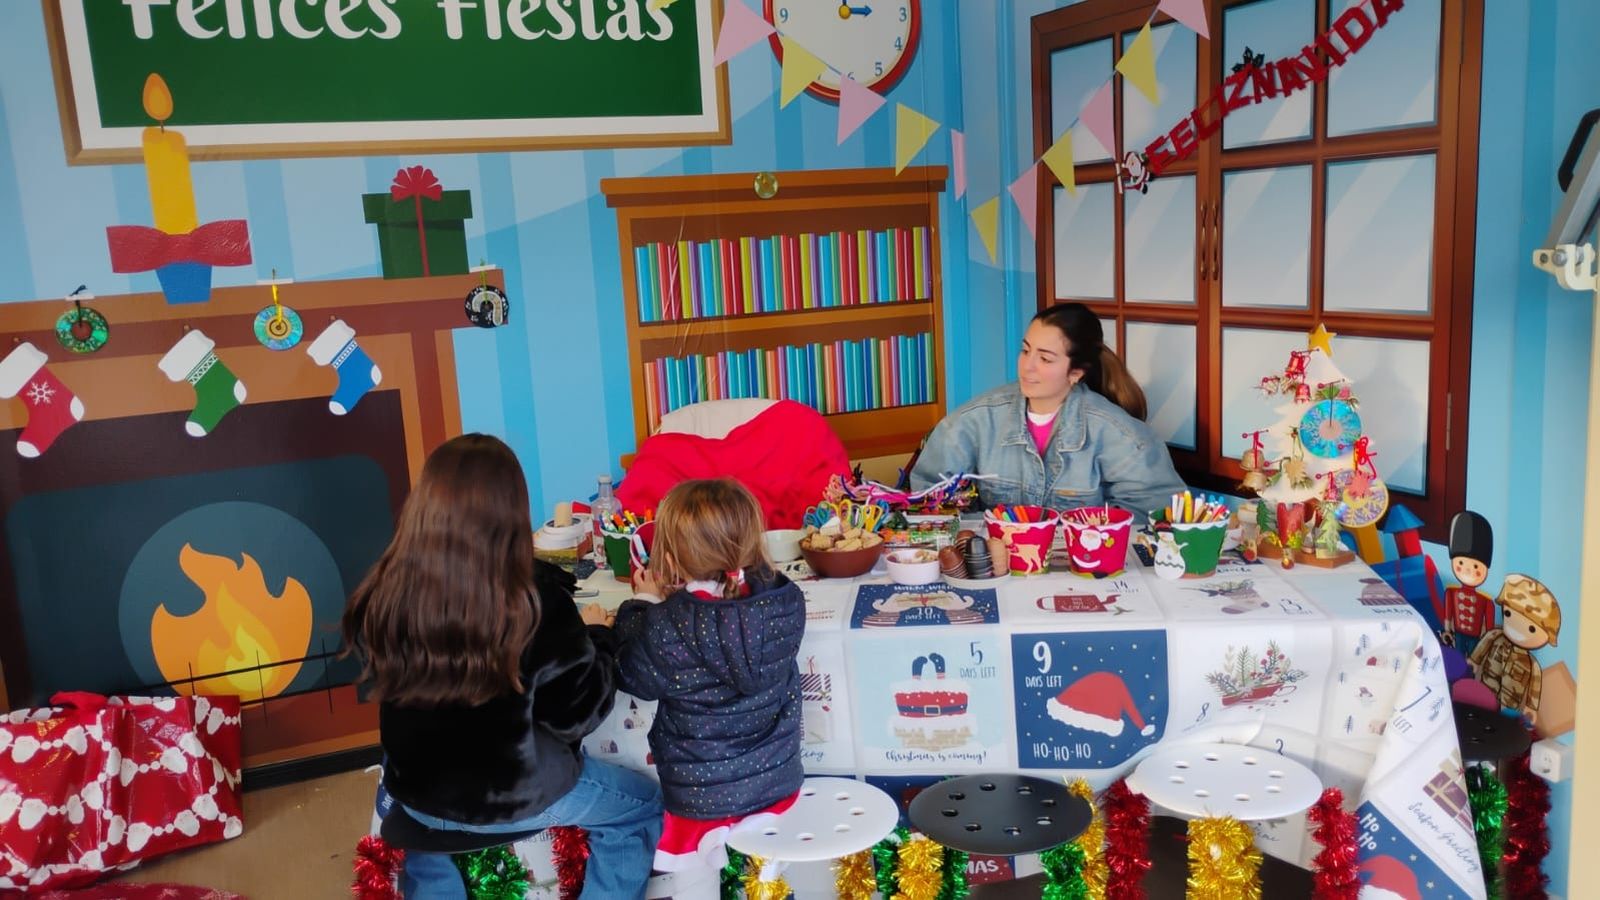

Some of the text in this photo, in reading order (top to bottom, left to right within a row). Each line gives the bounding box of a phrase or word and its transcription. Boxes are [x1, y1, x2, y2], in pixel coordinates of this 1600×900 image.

[437, 0, 673, 41] Fiestas
[779, 8, 788, 23] 9
[898, 7, 907, 22] 3
[894, 36, 903, 51] 4
[874, 61, 883, 77] 5
[969, 641, 983, 665] 5
[1032, 640, 1052, 674] 9
[960, 666, 996, 679] DAYS LEFT
[1025, 674, 1062, 688] DAYS LEFT
[1196, 702, 1210, 722] 8
[1393, 715, 1413, 734] LEFT
[1033, 742, 1092, 762] HO-HO-HO
